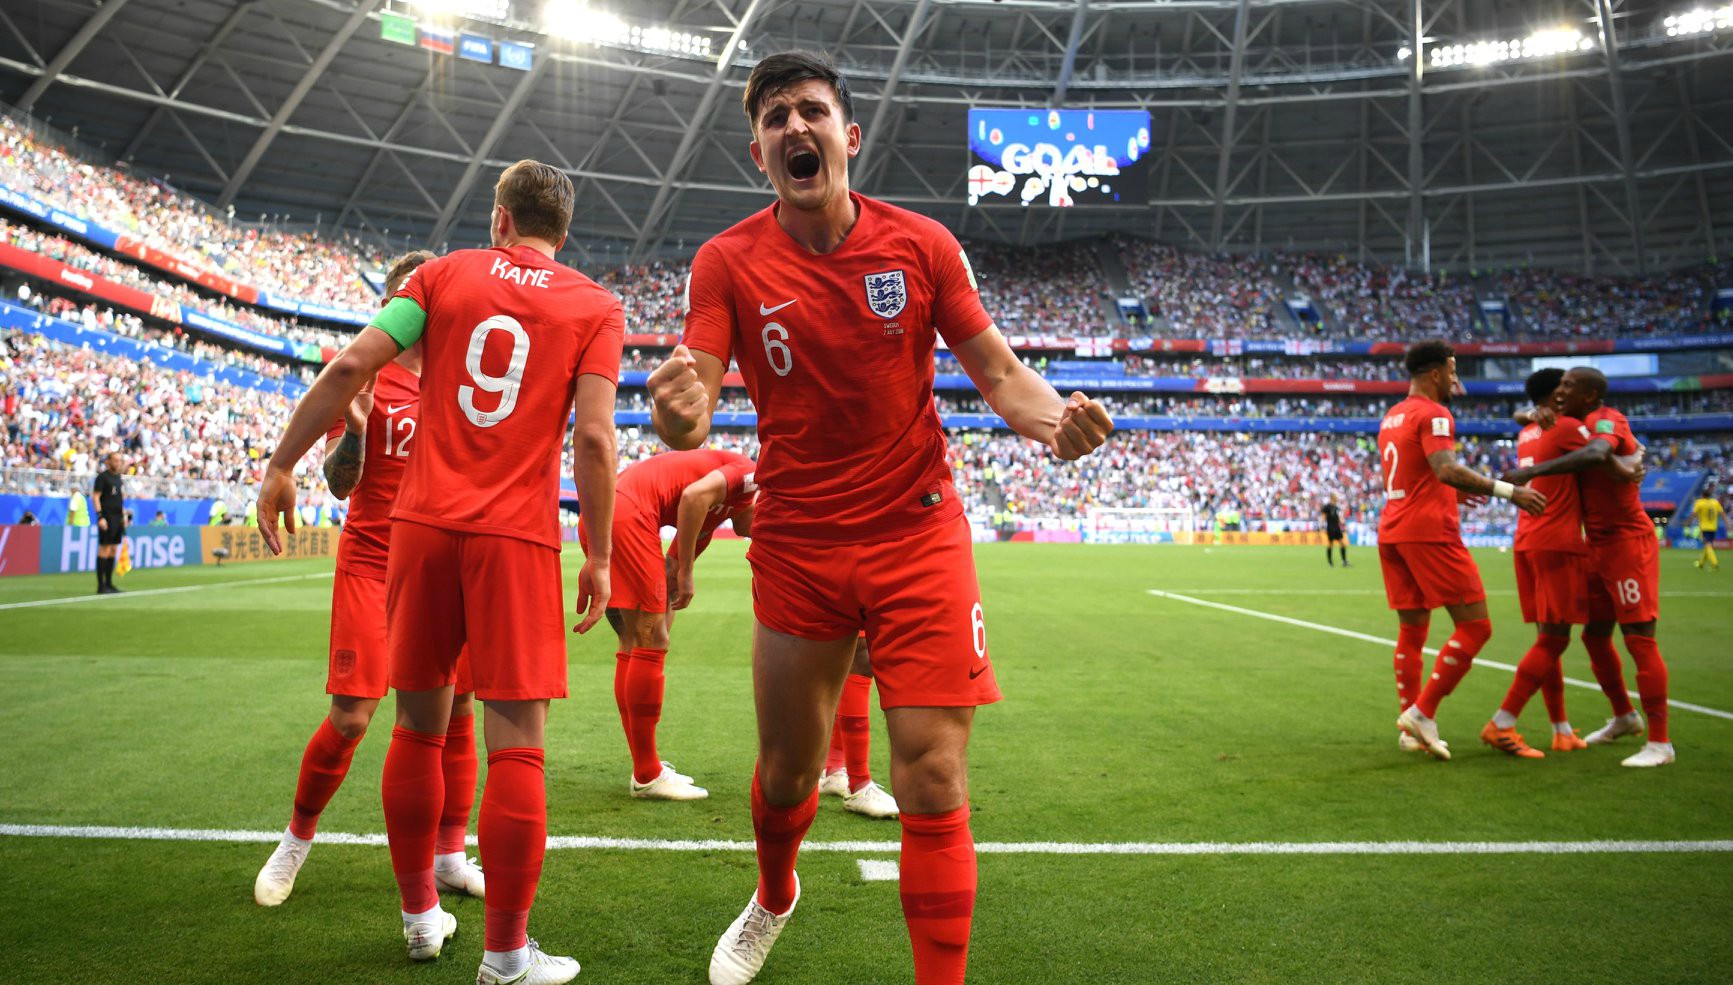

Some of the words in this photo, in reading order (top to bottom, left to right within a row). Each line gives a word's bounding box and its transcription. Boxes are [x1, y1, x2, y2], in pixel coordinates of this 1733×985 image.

[1001, 142, 1120, 176] GOAL
[490, 257, 554, 289] KANE
[457, 314, 531, 428] 9
[761, 321, 793, 377] 6
[384, 416, 417, 457] 12
[1383, 440, 1406, 500] 2
[60, 527, 185, 573] Hiense
[1617, 577, 1641, 606] 18
[970, 601, 987, 659] 6
